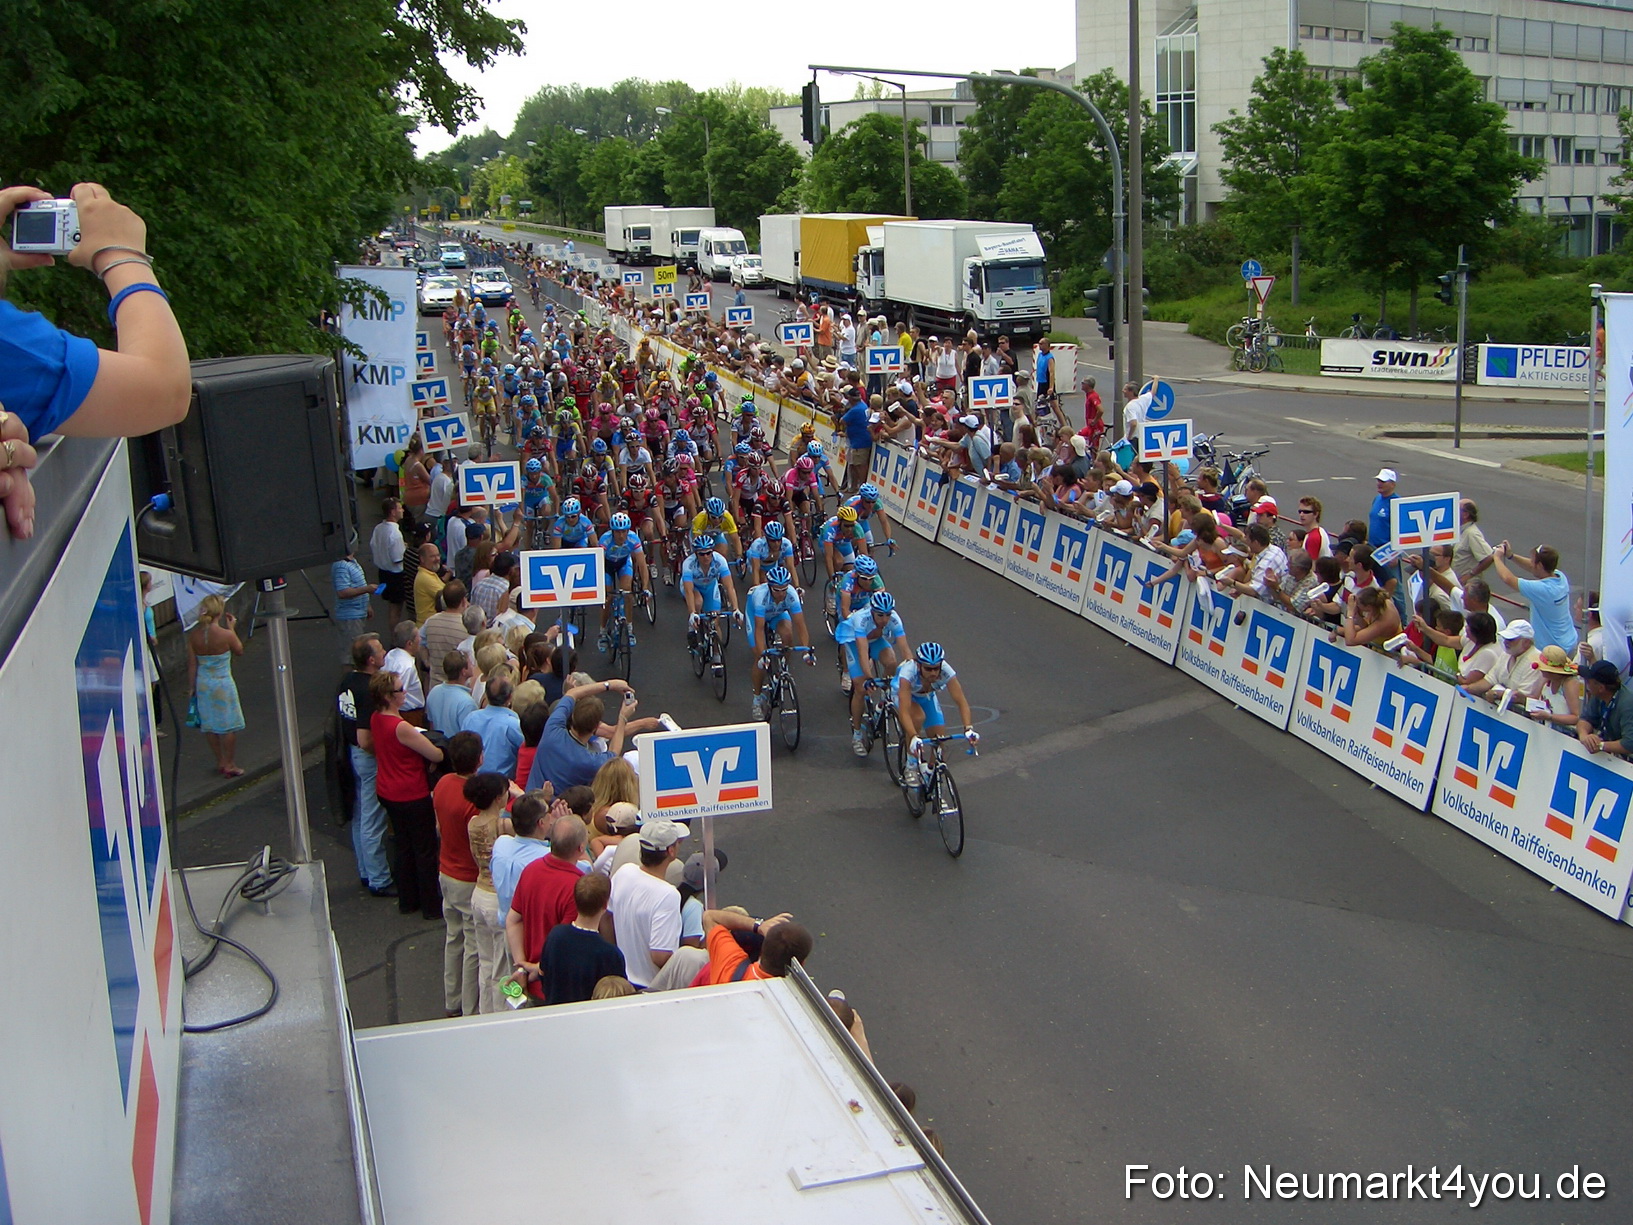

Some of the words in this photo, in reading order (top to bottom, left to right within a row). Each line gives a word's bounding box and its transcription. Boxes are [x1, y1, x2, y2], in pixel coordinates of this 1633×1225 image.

[657, 270, 675, 280] 50m
[1372, 350, 1428, 367] swn
[1521, 348, 1591, 368] PFLEID
[353, 363, 406, 386] KMP
[1520, 370, 1603, 383] AKTIENGESE
[357, 424, 411, 446] KMP
[1006, 558, 1035, 582] Volksbanken
[1035, 572, 1081, 603] Raiffeisenbanken
[1086, 597, 1120, 625] Volksbanken
[1120, 615, 1172, 652] Raiffeisenbanken
[1181, 646, 1220, 680] Volksbanken
[1221, 669, 1284, 715] Raiffeisenbanken
[1297, 709, 1347, 750] Volksbanken
[1348, 739, 1424, 794] Raiffeisenbanken
[647, 807, 699, 819] Volksbanken
[700, 799, 770, 813] Raiffeisenbanken
[1442, 787, 1509, 839] Volksbanken
[1511, 826, 1617, 900] Raiffeisenbanken
